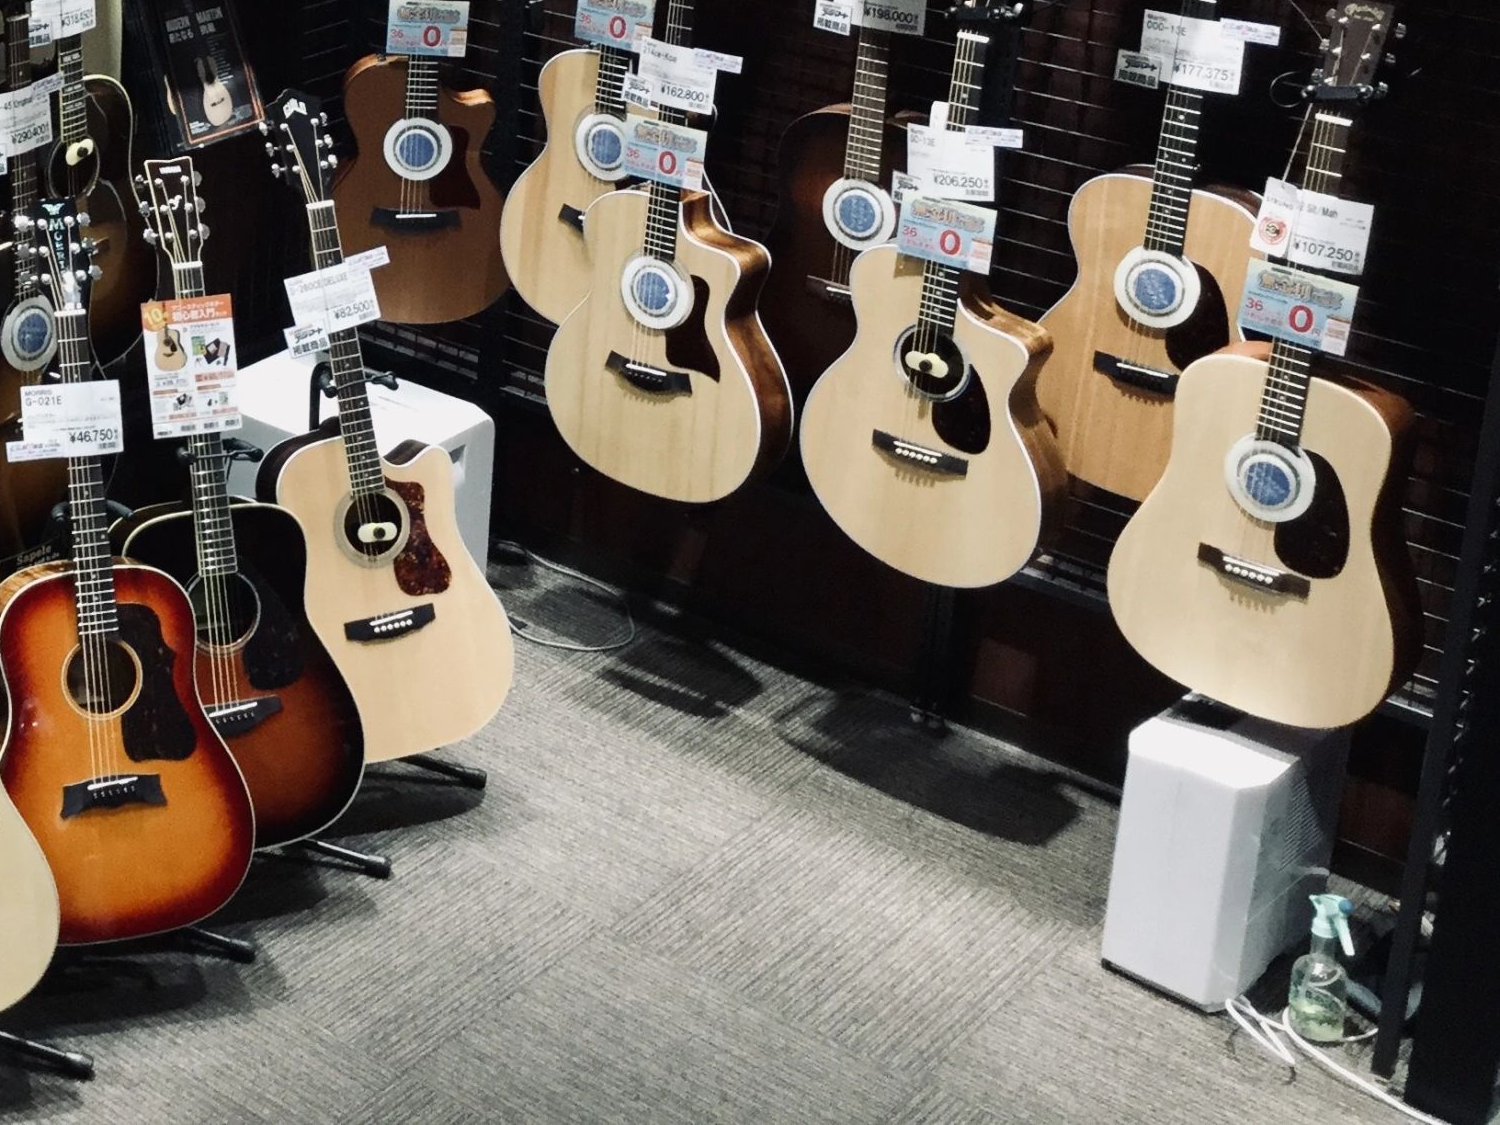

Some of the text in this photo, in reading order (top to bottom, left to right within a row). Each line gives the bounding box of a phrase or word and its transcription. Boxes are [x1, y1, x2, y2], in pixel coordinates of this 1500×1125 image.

[422, 24, 442, 48] 0
[608, 15, 627, 39] 0
[658, 150, 678, 176] 0
[902, 225, 962, 256] 36 0
[1245, 297, 1314, 333] 36 0
[25, 395, 63, 408] G-021E
[68, 427, 114, 445] ¥46,750
